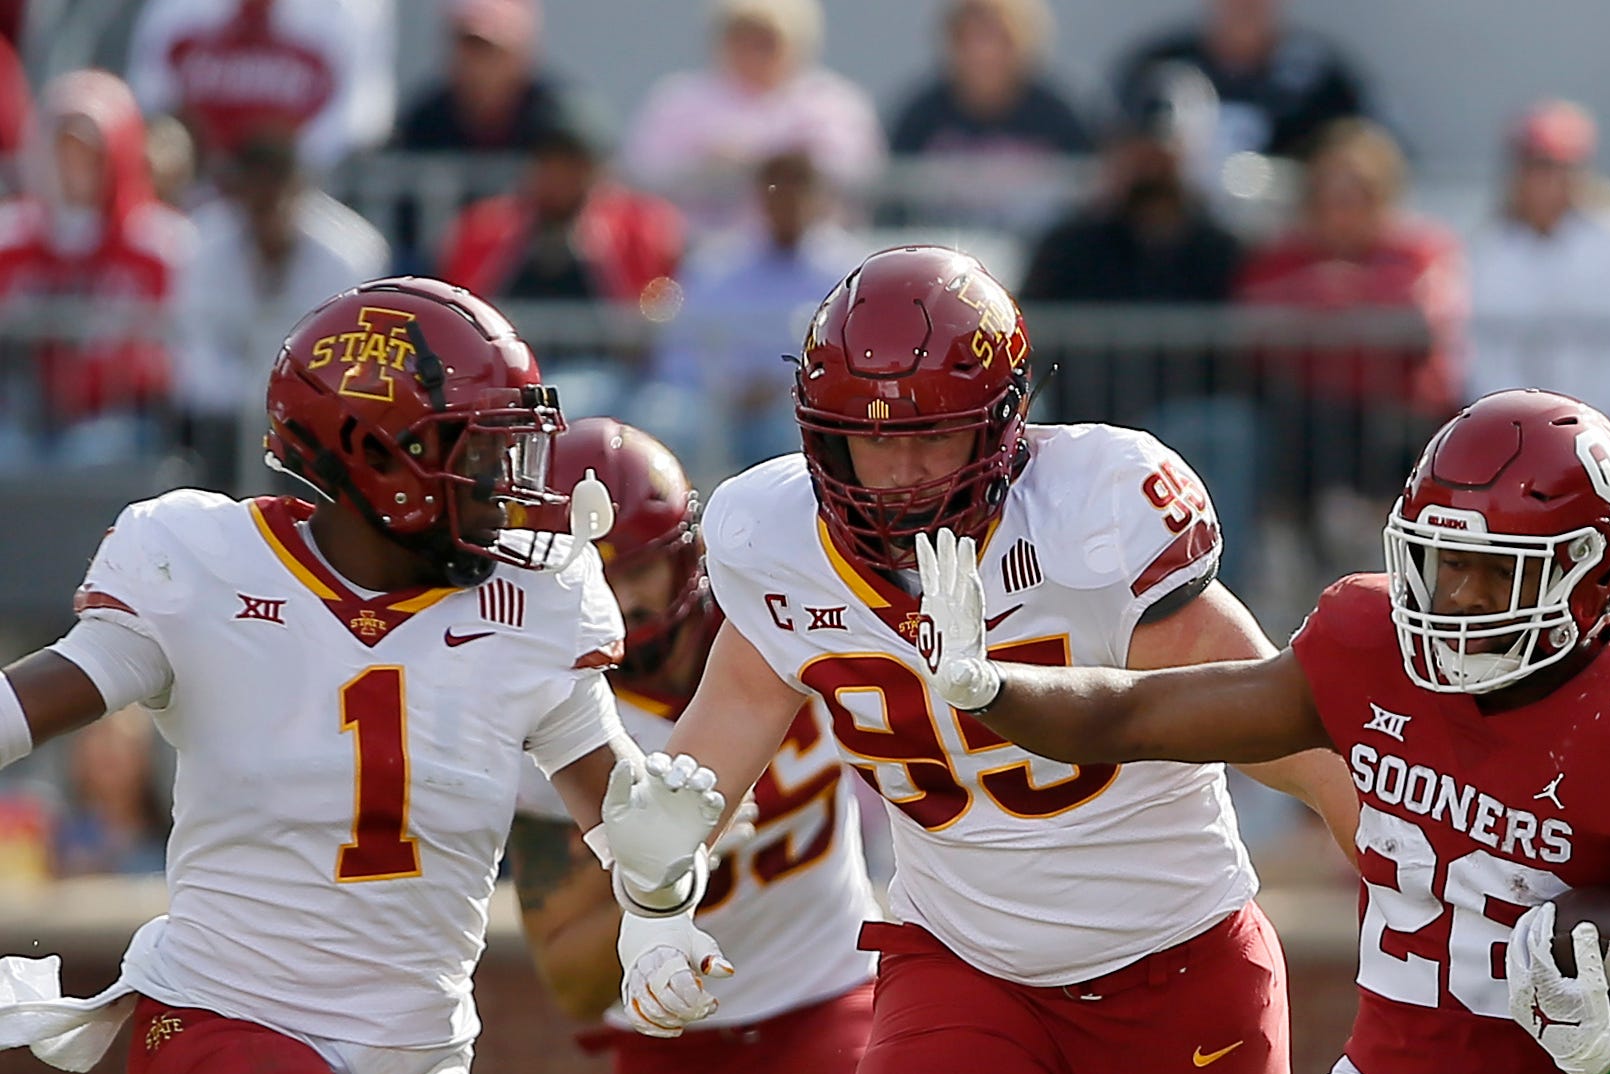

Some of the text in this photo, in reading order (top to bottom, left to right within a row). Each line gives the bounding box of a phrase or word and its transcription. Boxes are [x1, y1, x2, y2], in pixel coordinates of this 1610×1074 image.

[308, 331, 418, 370] STAT
[1142, 461, 1206, 534] 95
[235, 593, 287, 625] XII
[350, 617, 387, 631] STATE
[764, 593, 795, 632] C
[804, 605, 849, 631] XII
[918, 614, 943, 675] OU
[799, 633, 1121, 832] 95
[1363, 702, 1412, 742] XII
[337, 664, 422, 884] 1
[1351, 743, 1574, 863] SOONERS
[1355, 801, 1576, 1020] 26
